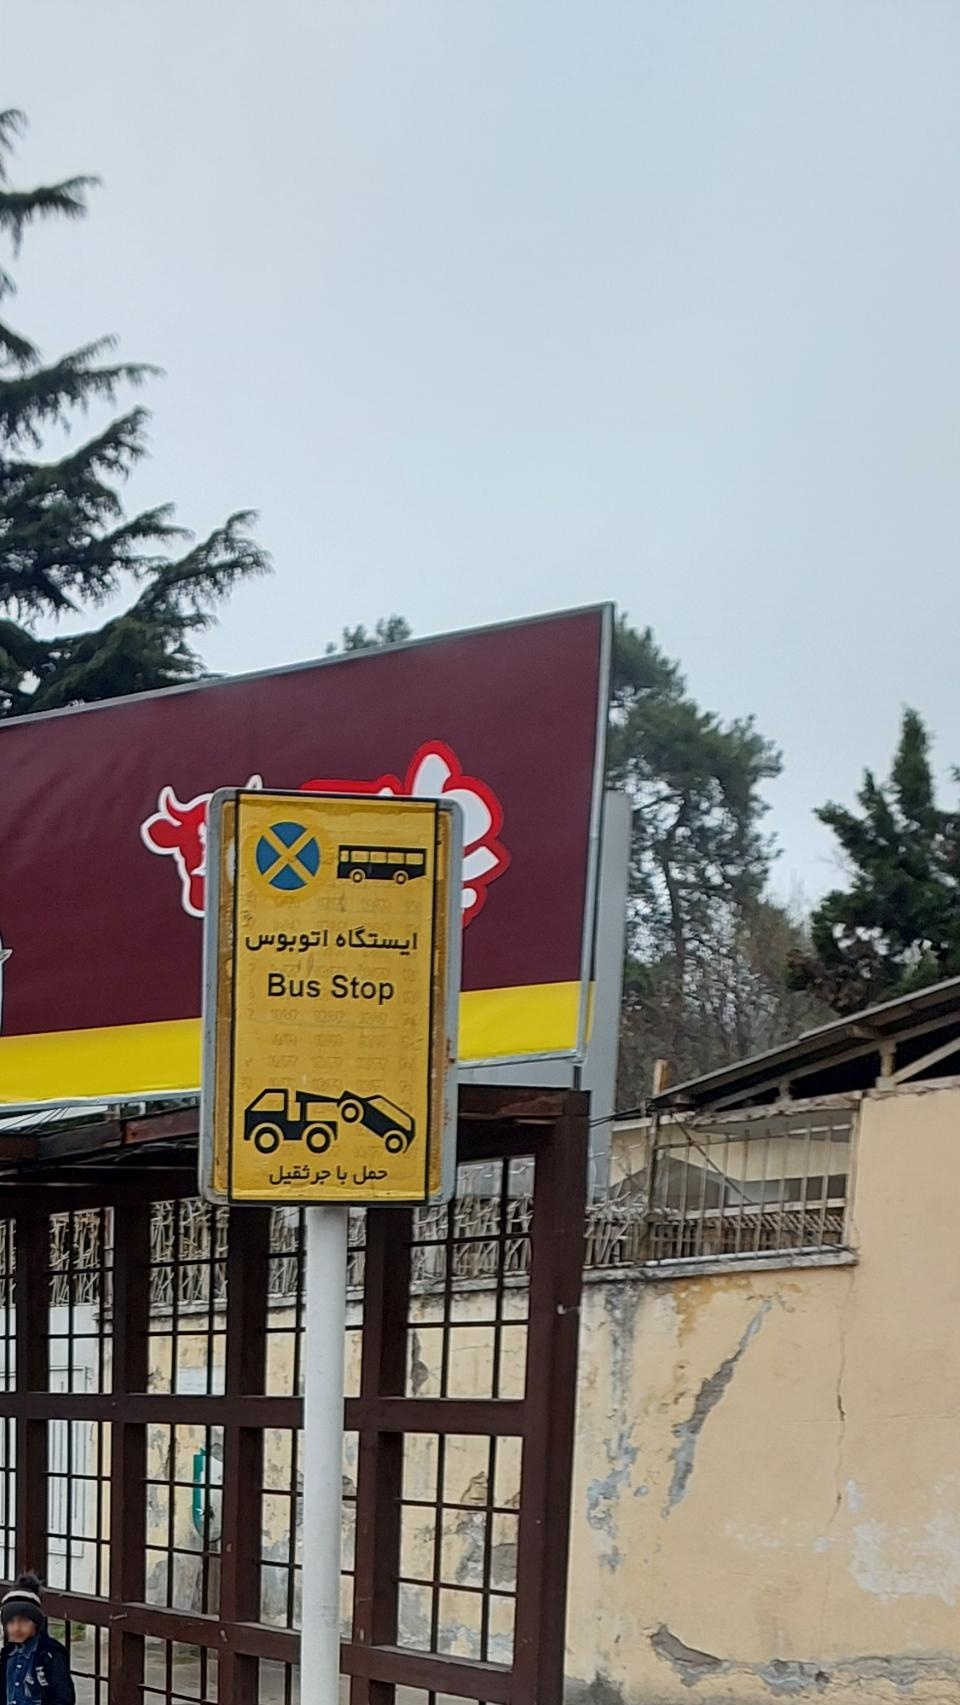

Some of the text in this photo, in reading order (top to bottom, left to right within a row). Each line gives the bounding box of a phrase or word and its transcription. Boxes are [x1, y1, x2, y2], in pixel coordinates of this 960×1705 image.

[245, 926, 417, 955] ایستگاه اتوبوس
[267, 973, 395, 1005] Bus Stop
[336, 1165, 347, 1185] با
[353, 1165, 388, 1185] حمل
